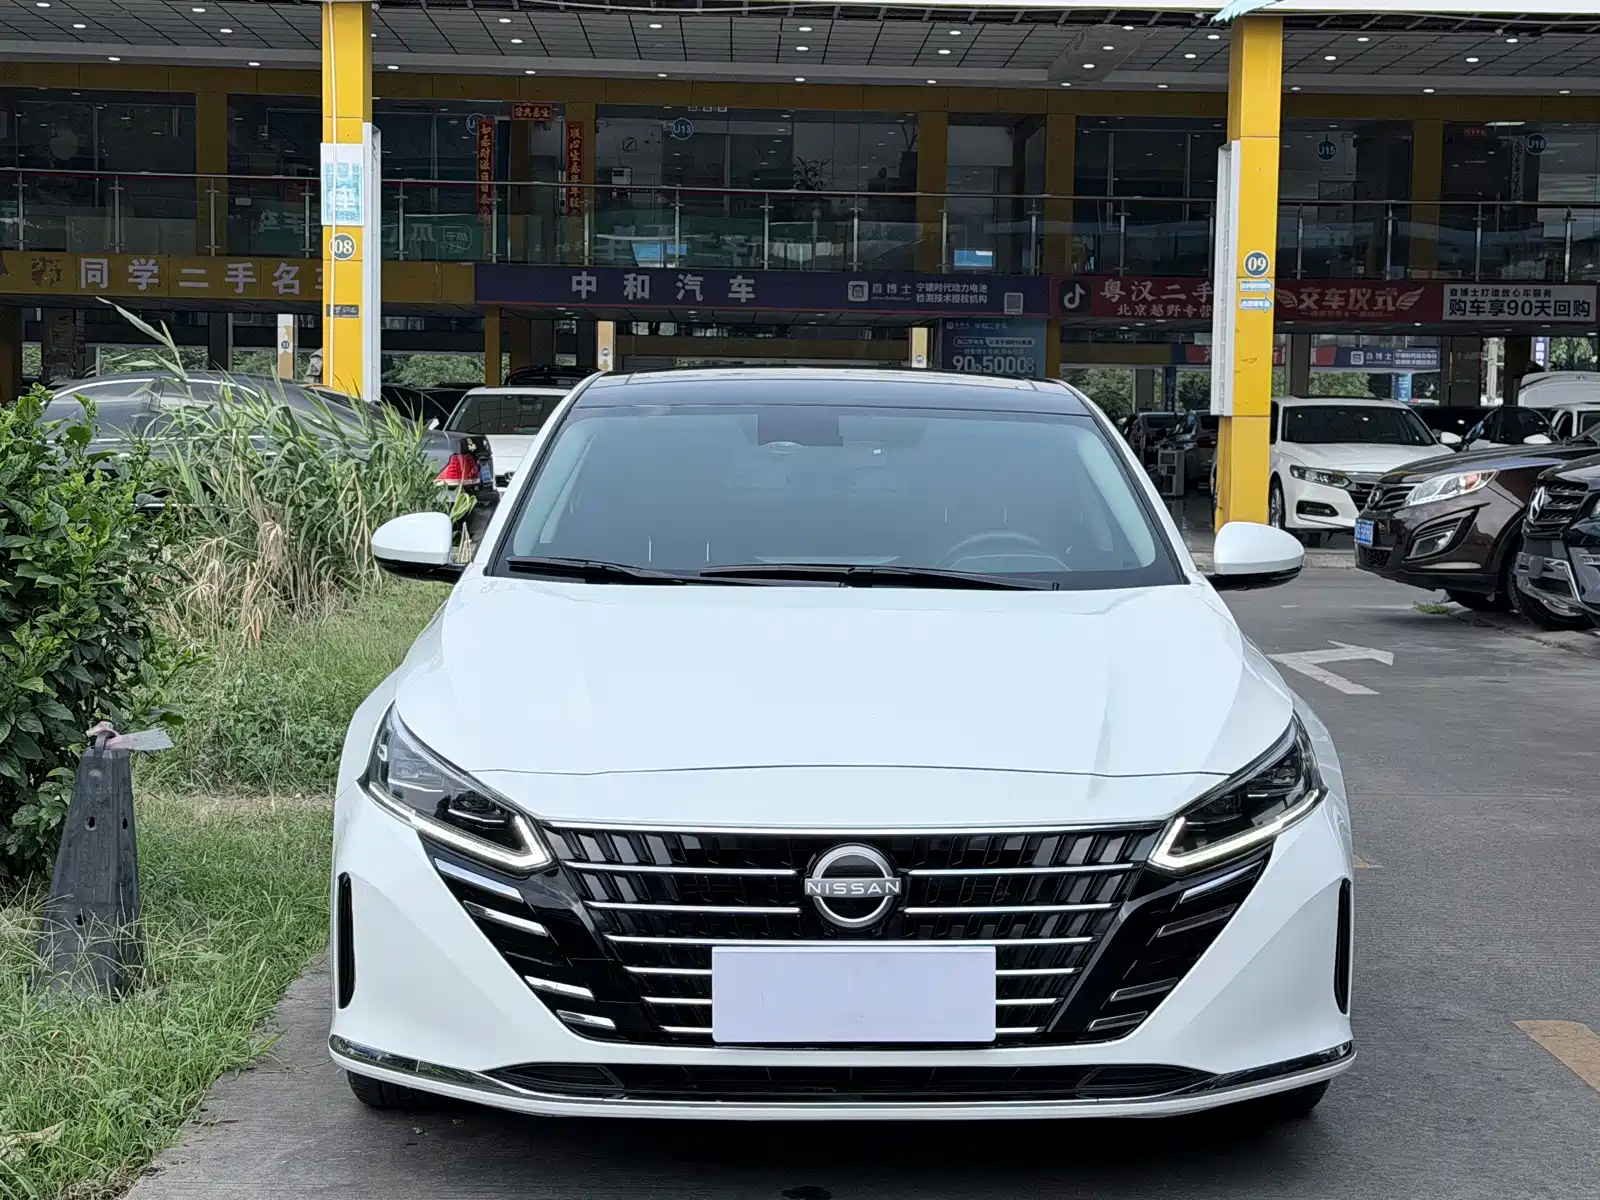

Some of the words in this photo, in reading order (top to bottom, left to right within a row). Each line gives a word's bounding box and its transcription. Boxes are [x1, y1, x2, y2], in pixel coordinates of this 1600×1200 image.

[673, 124, 692, 136] U13
[334, 239, 353, 255] 08
[1247, 256, 1267, 271] 09
[80, 257, 322, 295] 同学二手名
[571, 270, 756, 304] 中和汽车
[916, 282, 988, 293] 宁德时代动力电池
[1099, 278, 1213, 303] 粤汉二手
[1297, 287, 1397, 312] 交车仪式
[1448, 298, 1591, 317] 购车享90天回购
[806, 880, 900, 894] NISSAN
